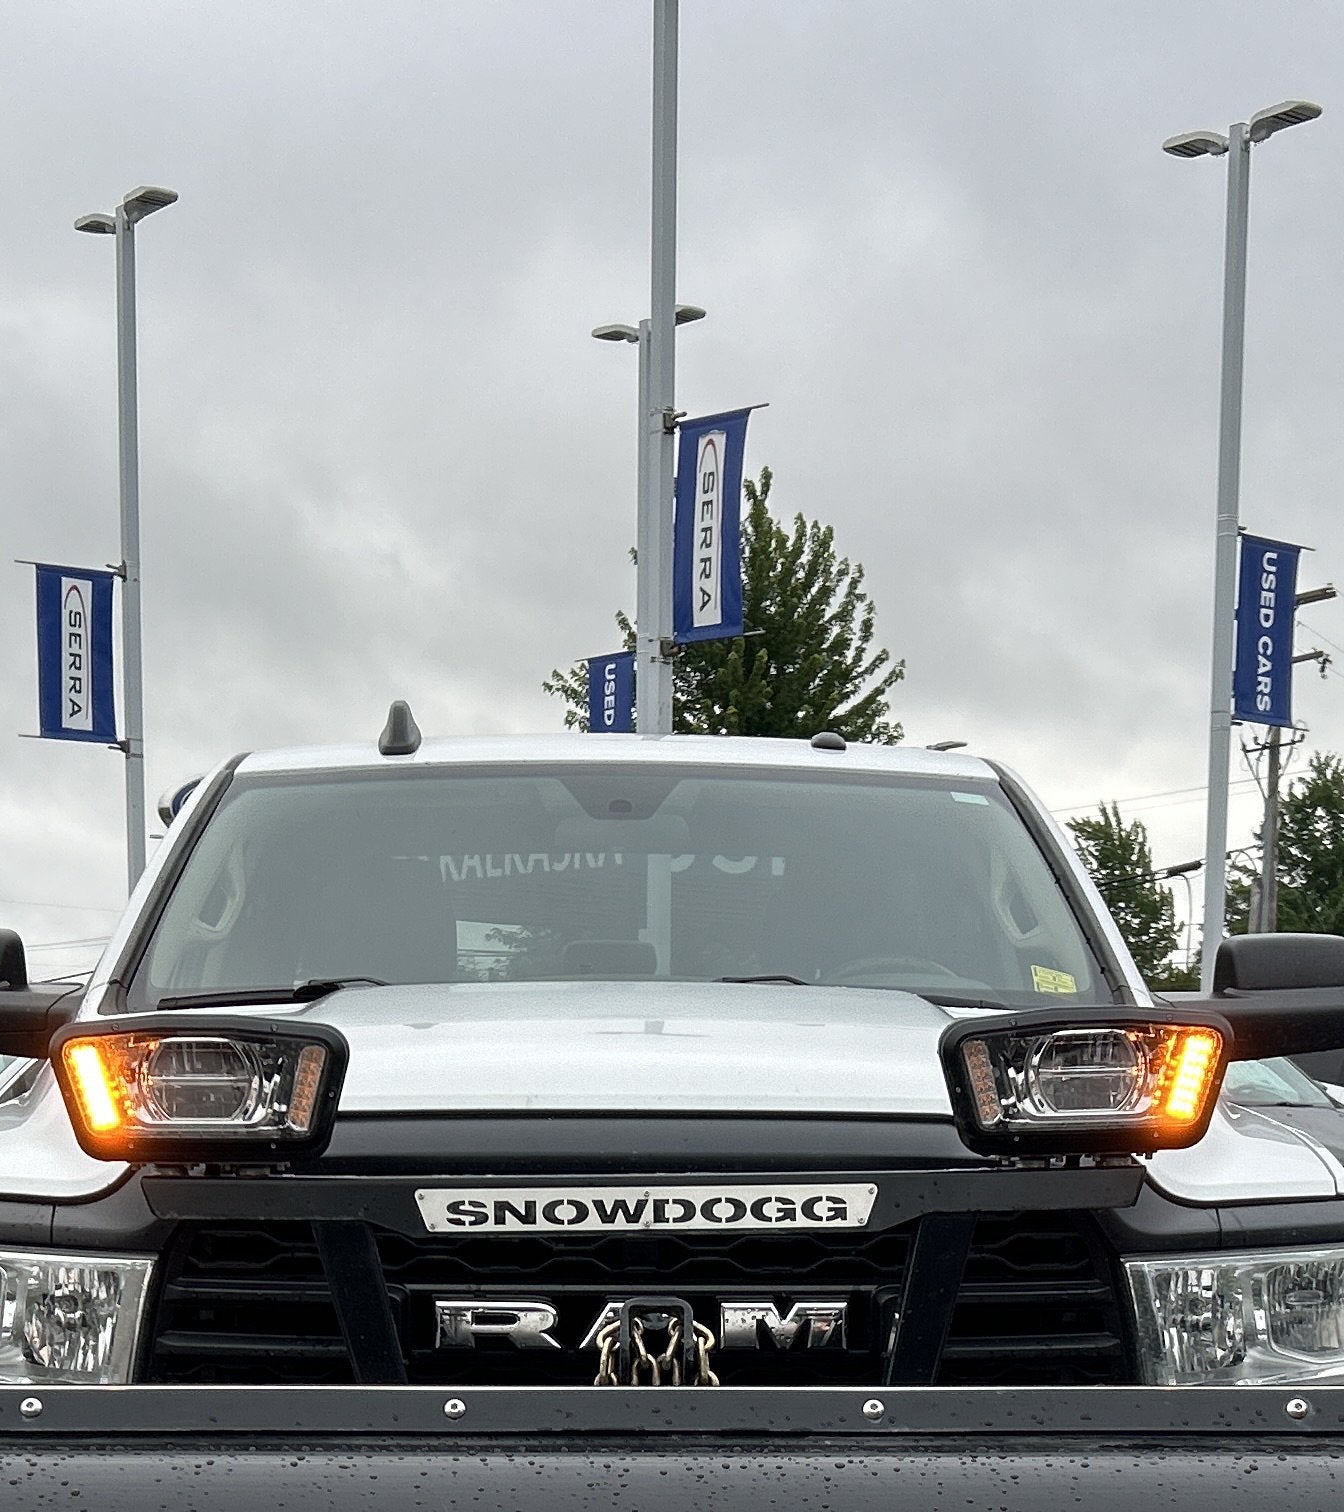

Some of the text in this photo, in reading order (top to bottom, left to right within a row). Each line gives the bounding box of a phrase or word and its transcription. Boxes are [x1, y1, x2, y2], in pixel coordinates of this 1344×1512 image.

[699, 470, 715, 613] SERRA
[67, 609, 83, 718] SERRA
[1255, 551, 1278, 712] USED CARS
[604, 663, 617, 726] USED
[445, 1195, 849, 1227] SNOWDOGG
